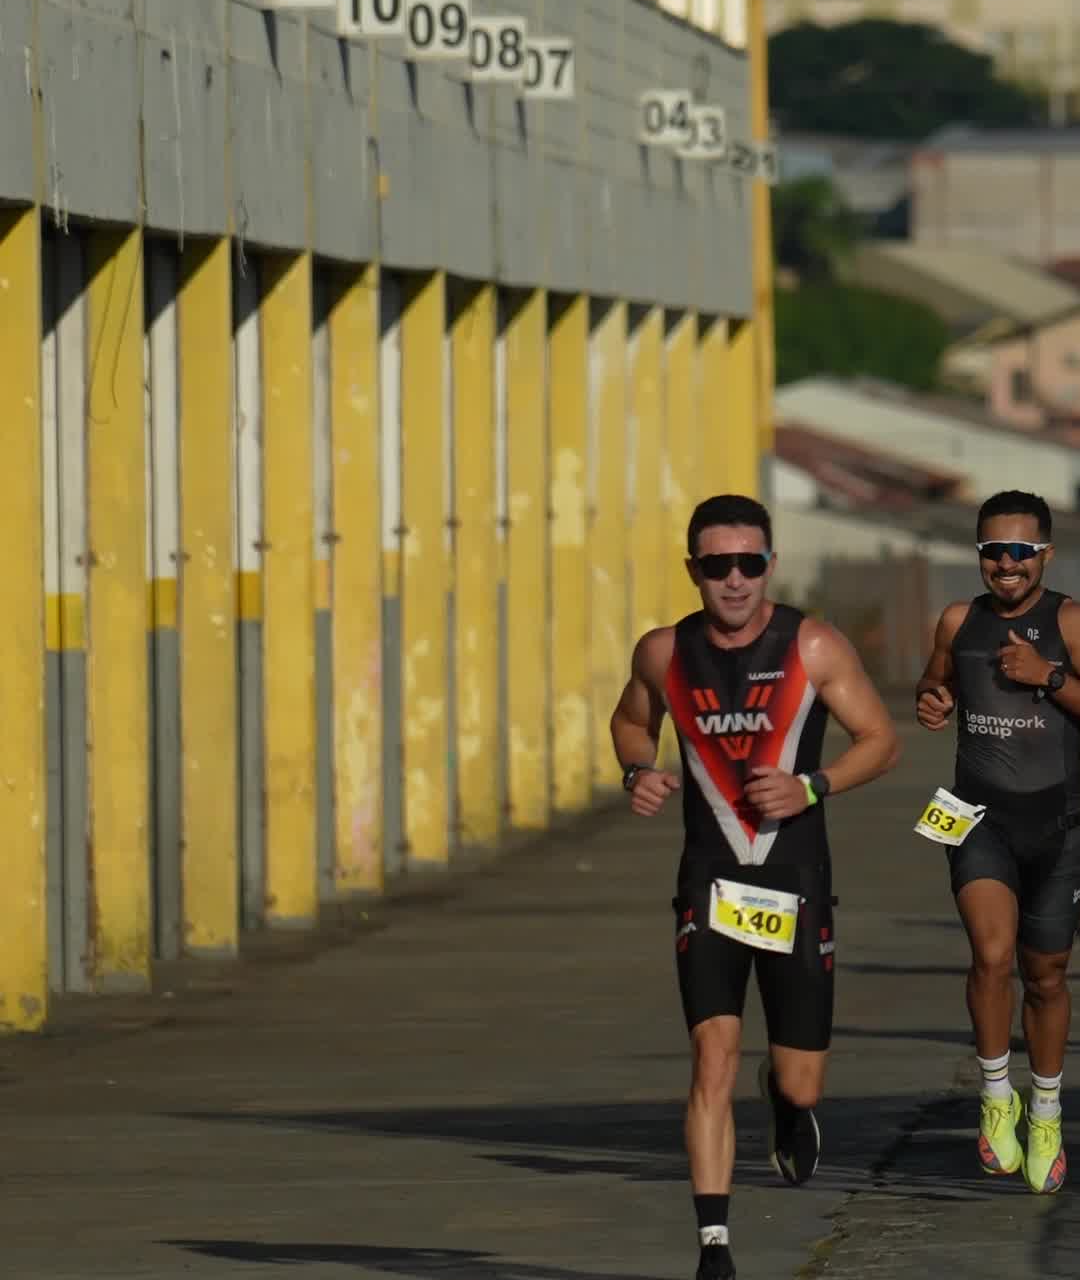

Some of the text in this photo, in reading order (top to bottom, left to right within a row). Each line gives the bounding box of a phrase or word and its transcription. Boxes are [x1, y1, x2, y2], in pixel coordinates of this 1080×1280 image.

[409, 3, 466, 49] 09
[472, 27, 522, 69] 08
[695, 712, 774, 735] VIANA
[965, 710, 1047, 729] leanwork
[967, 722, 1013, 739] group
[927, 808, 957, 832] 63
[732, 908, 782, 934] 140
